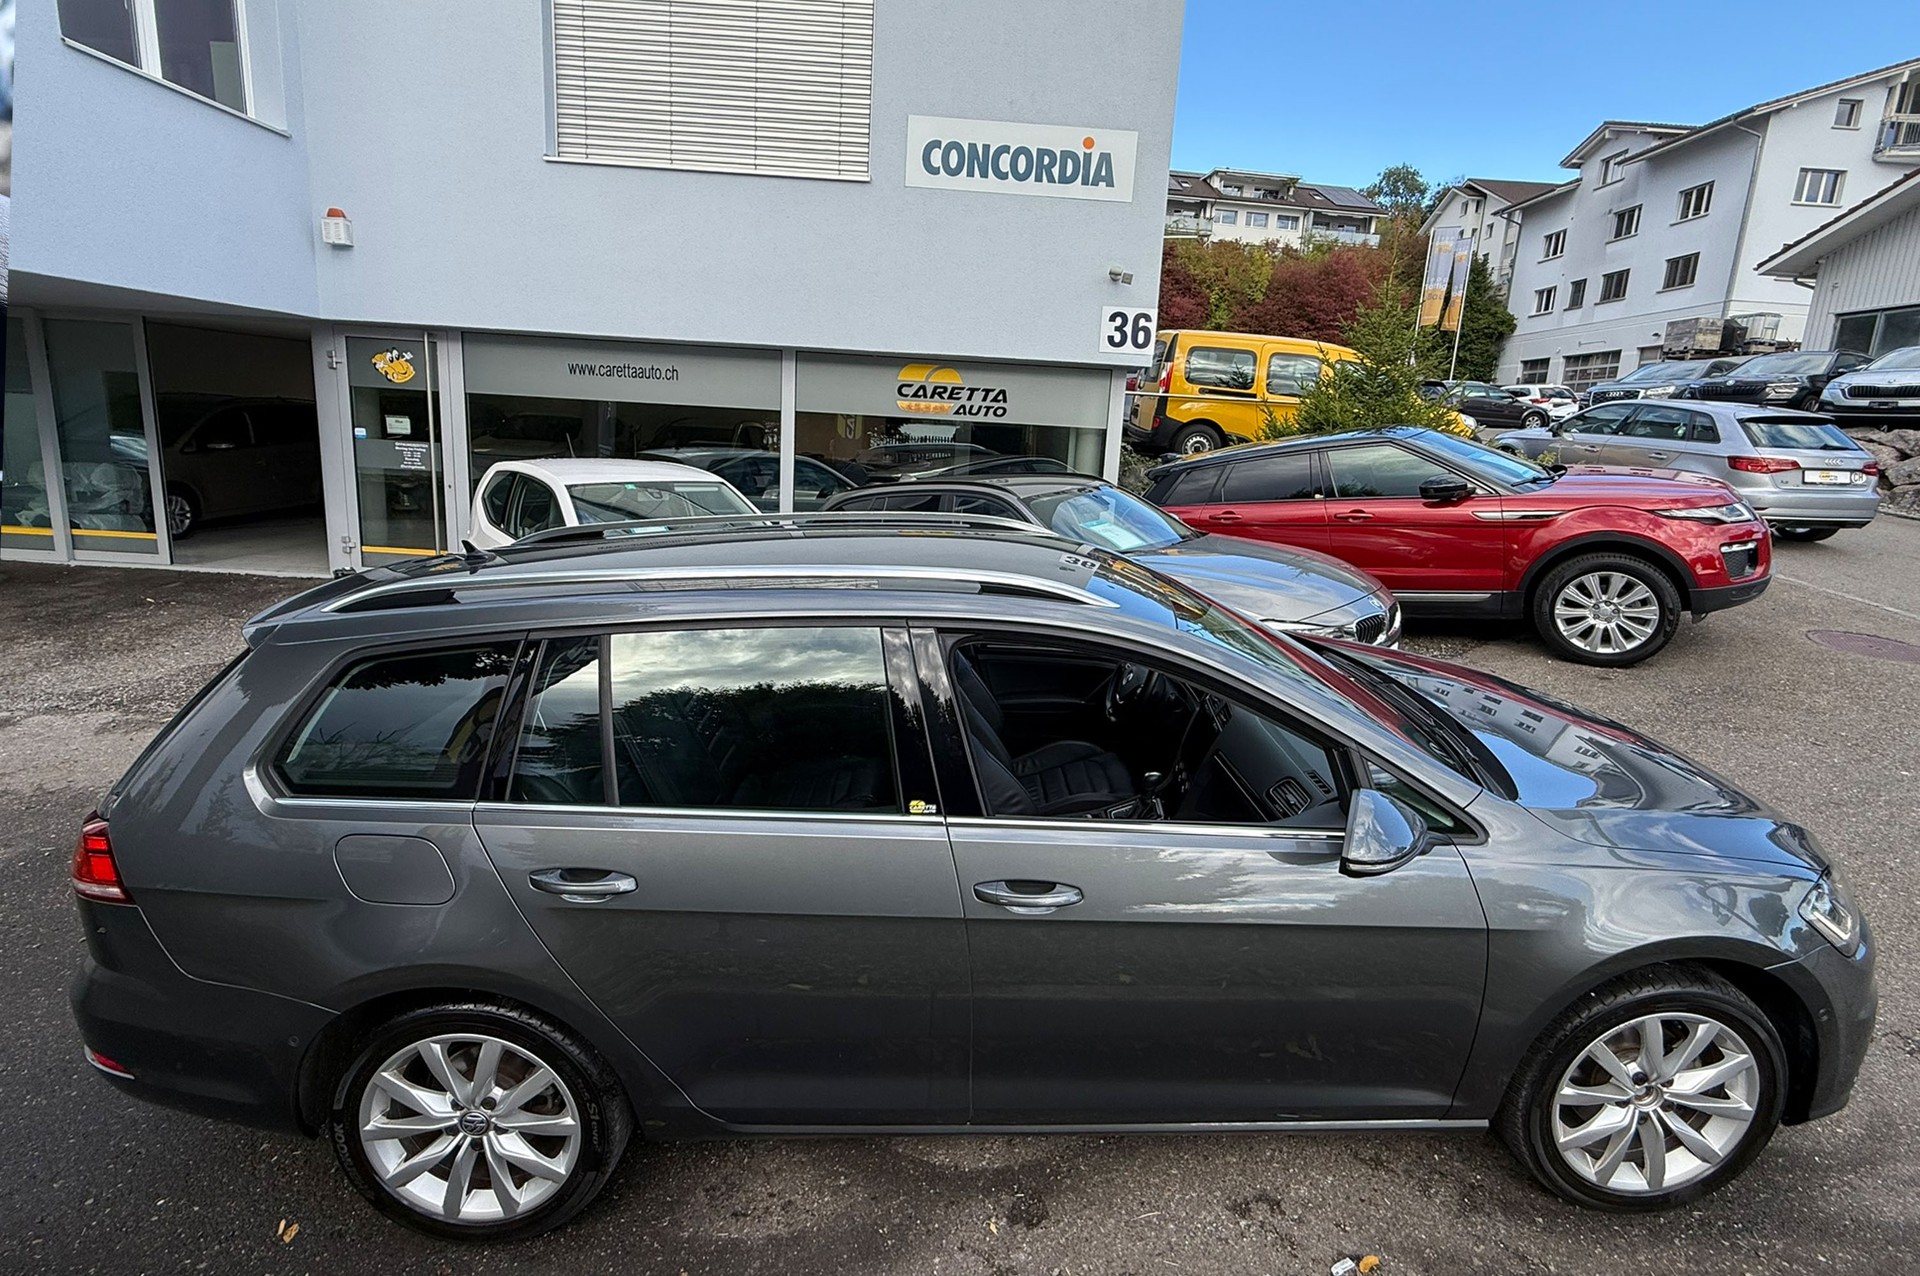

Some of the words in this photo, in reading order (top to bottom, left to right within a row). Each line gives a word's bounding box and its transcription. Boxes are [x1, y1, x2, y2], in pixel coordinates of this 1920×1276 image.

[921, 136, 1116, 188] CONCORDIA
[1106, 311, 1153, 349] 36
[567, 362, 679, 381] www.carettaauto.ch
[897, 383, 1008, 404] CARETTA
[953, 404, 1007, 418] AUTO
